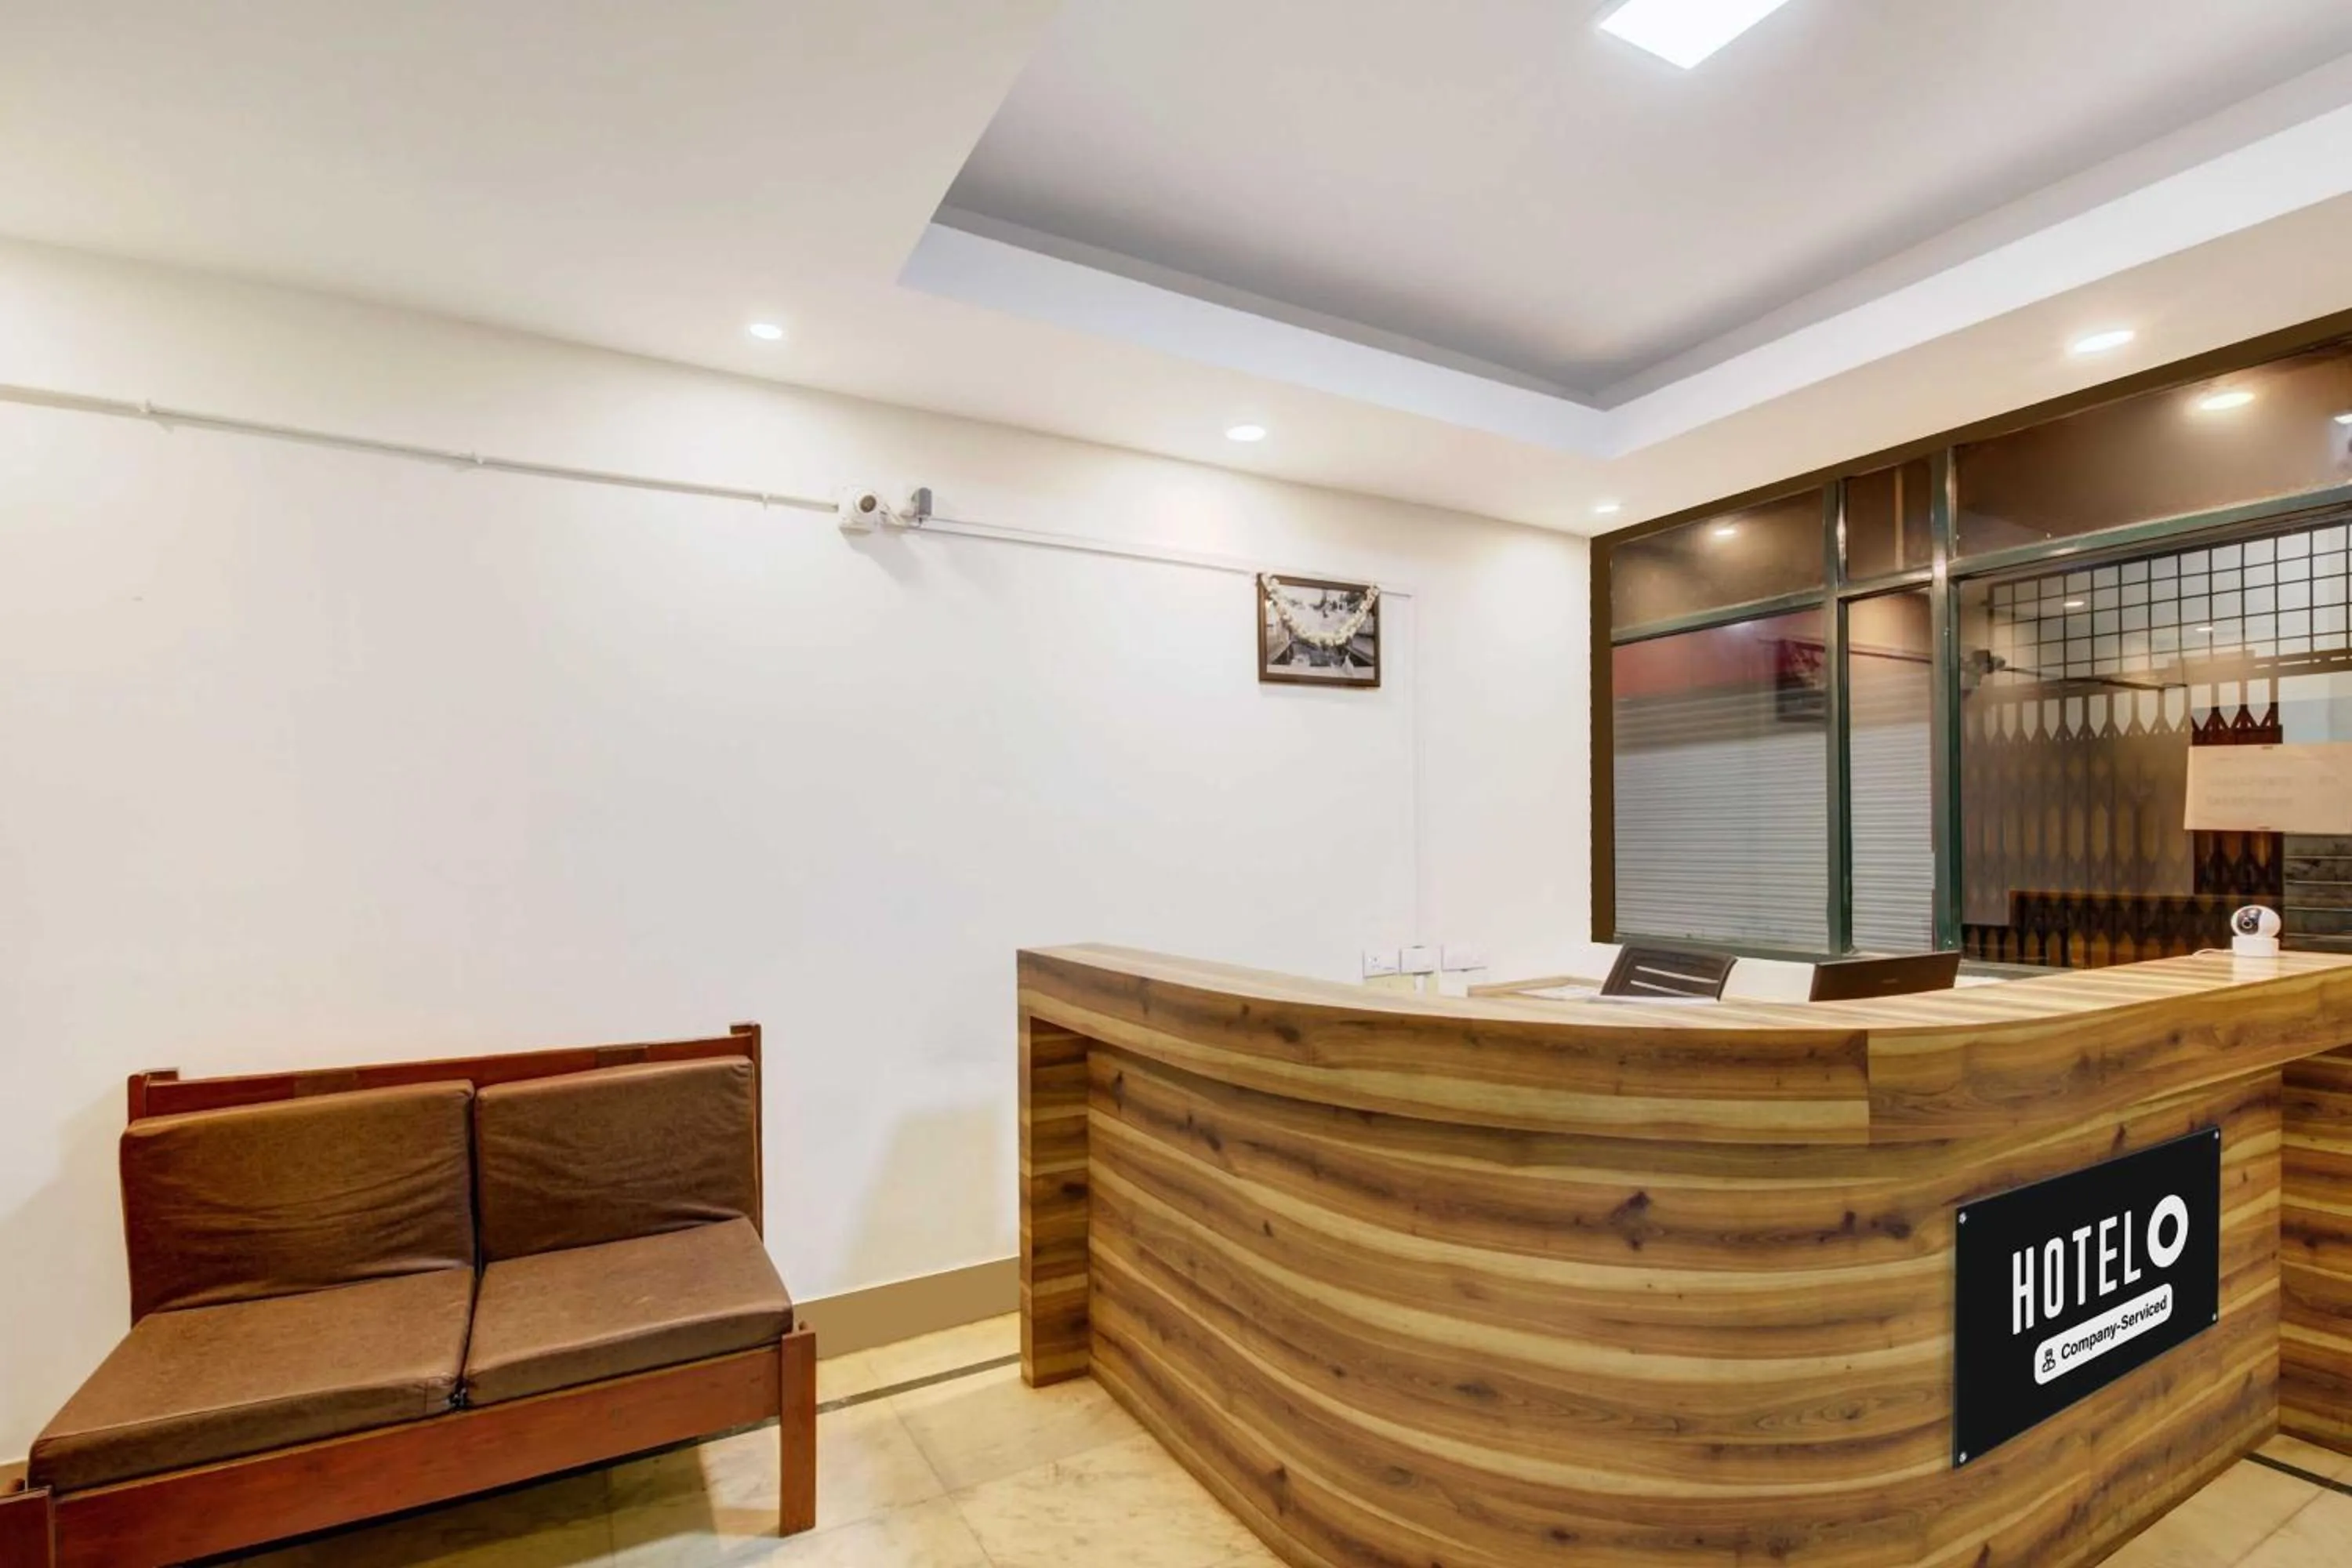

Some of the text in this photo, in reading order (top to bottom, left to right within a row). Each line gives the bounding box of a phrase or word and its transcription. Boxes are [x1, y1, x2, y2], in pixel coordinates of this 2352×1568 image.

[2013, 1194, 2189, 1335] HOTEL O
[2060, 1295, 2168, 1360] Company-Serviced
